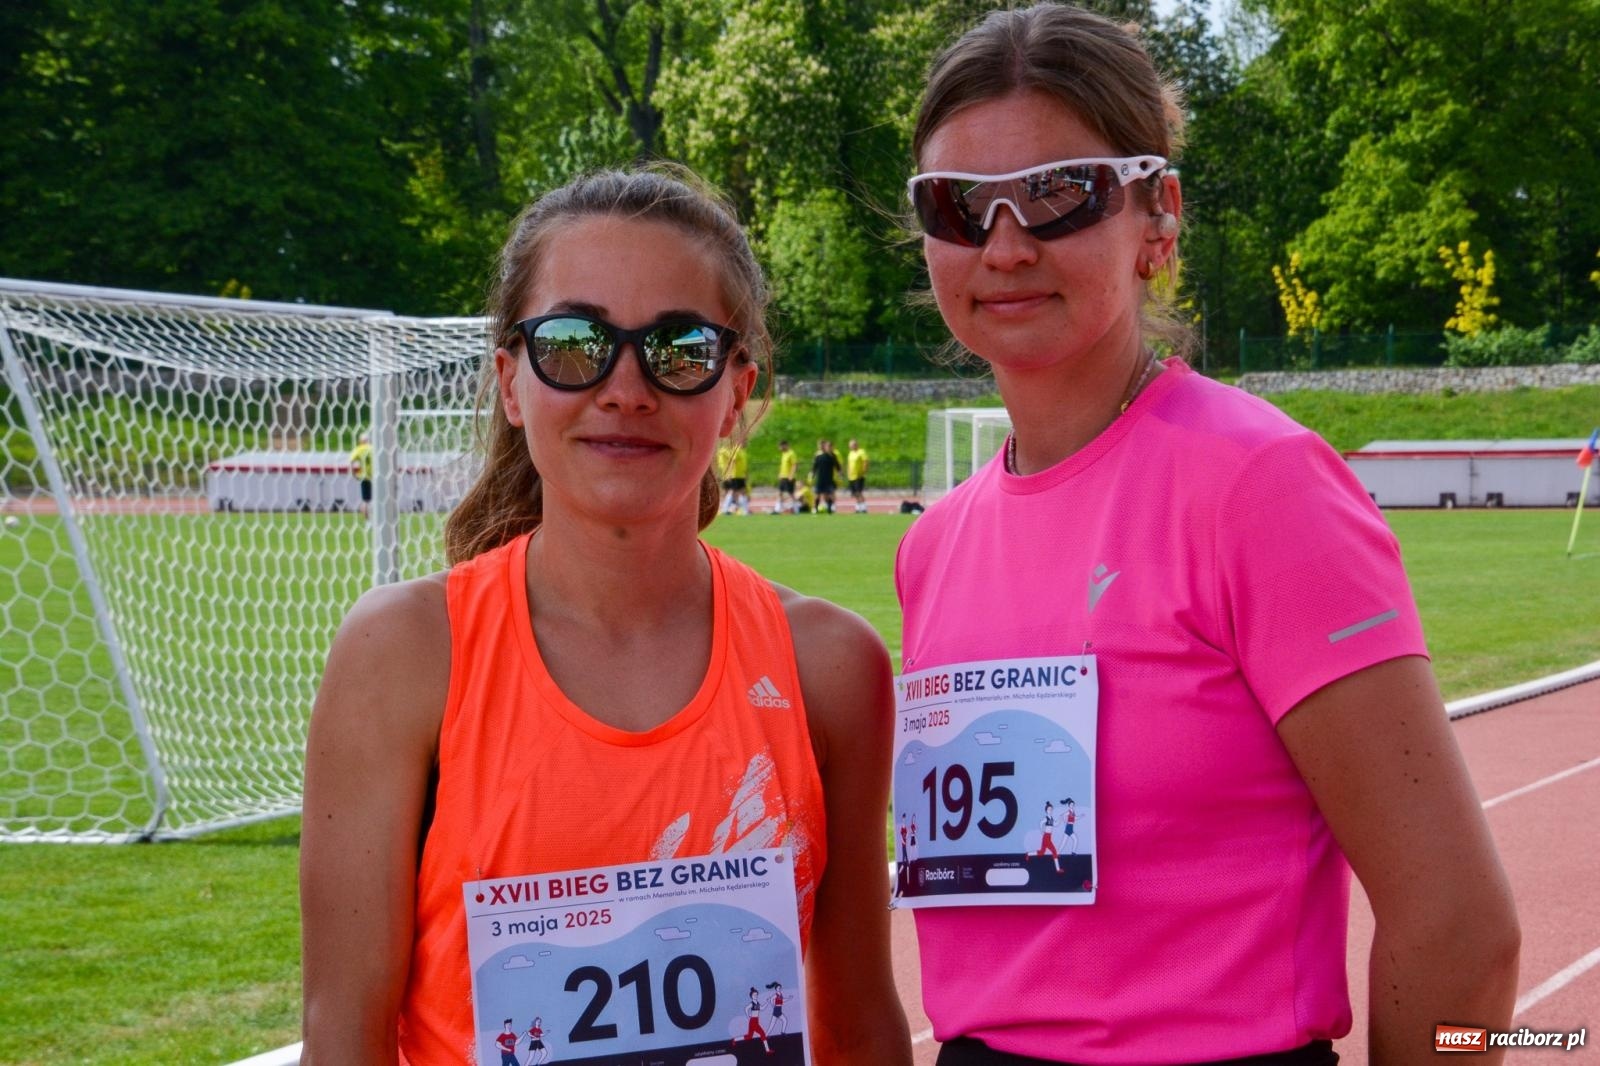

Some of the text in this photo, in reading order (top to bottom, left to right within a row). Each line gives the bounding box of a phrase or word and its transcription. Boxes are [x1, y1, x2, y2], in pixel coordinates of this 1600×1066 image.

[905, 665, 1077, 702] XVII BIEG BEZ GRANIC
[748, 695, 791, 709] adidas
[903, 709, 950, 735] 3 maja 2025
[922, 761, 1019, 842] 195
[489, 856, 768, 906] XVII BIEG BEZ GRANIC
[925, 867, 955, 881] Racibórz
[625, 893, 651, 903] ramach
[726, 880, 770, 892] Kędzierskiego
[491, 908, 612, 937] 3 maja 2025
[563, 954, 716, 1044] 210
